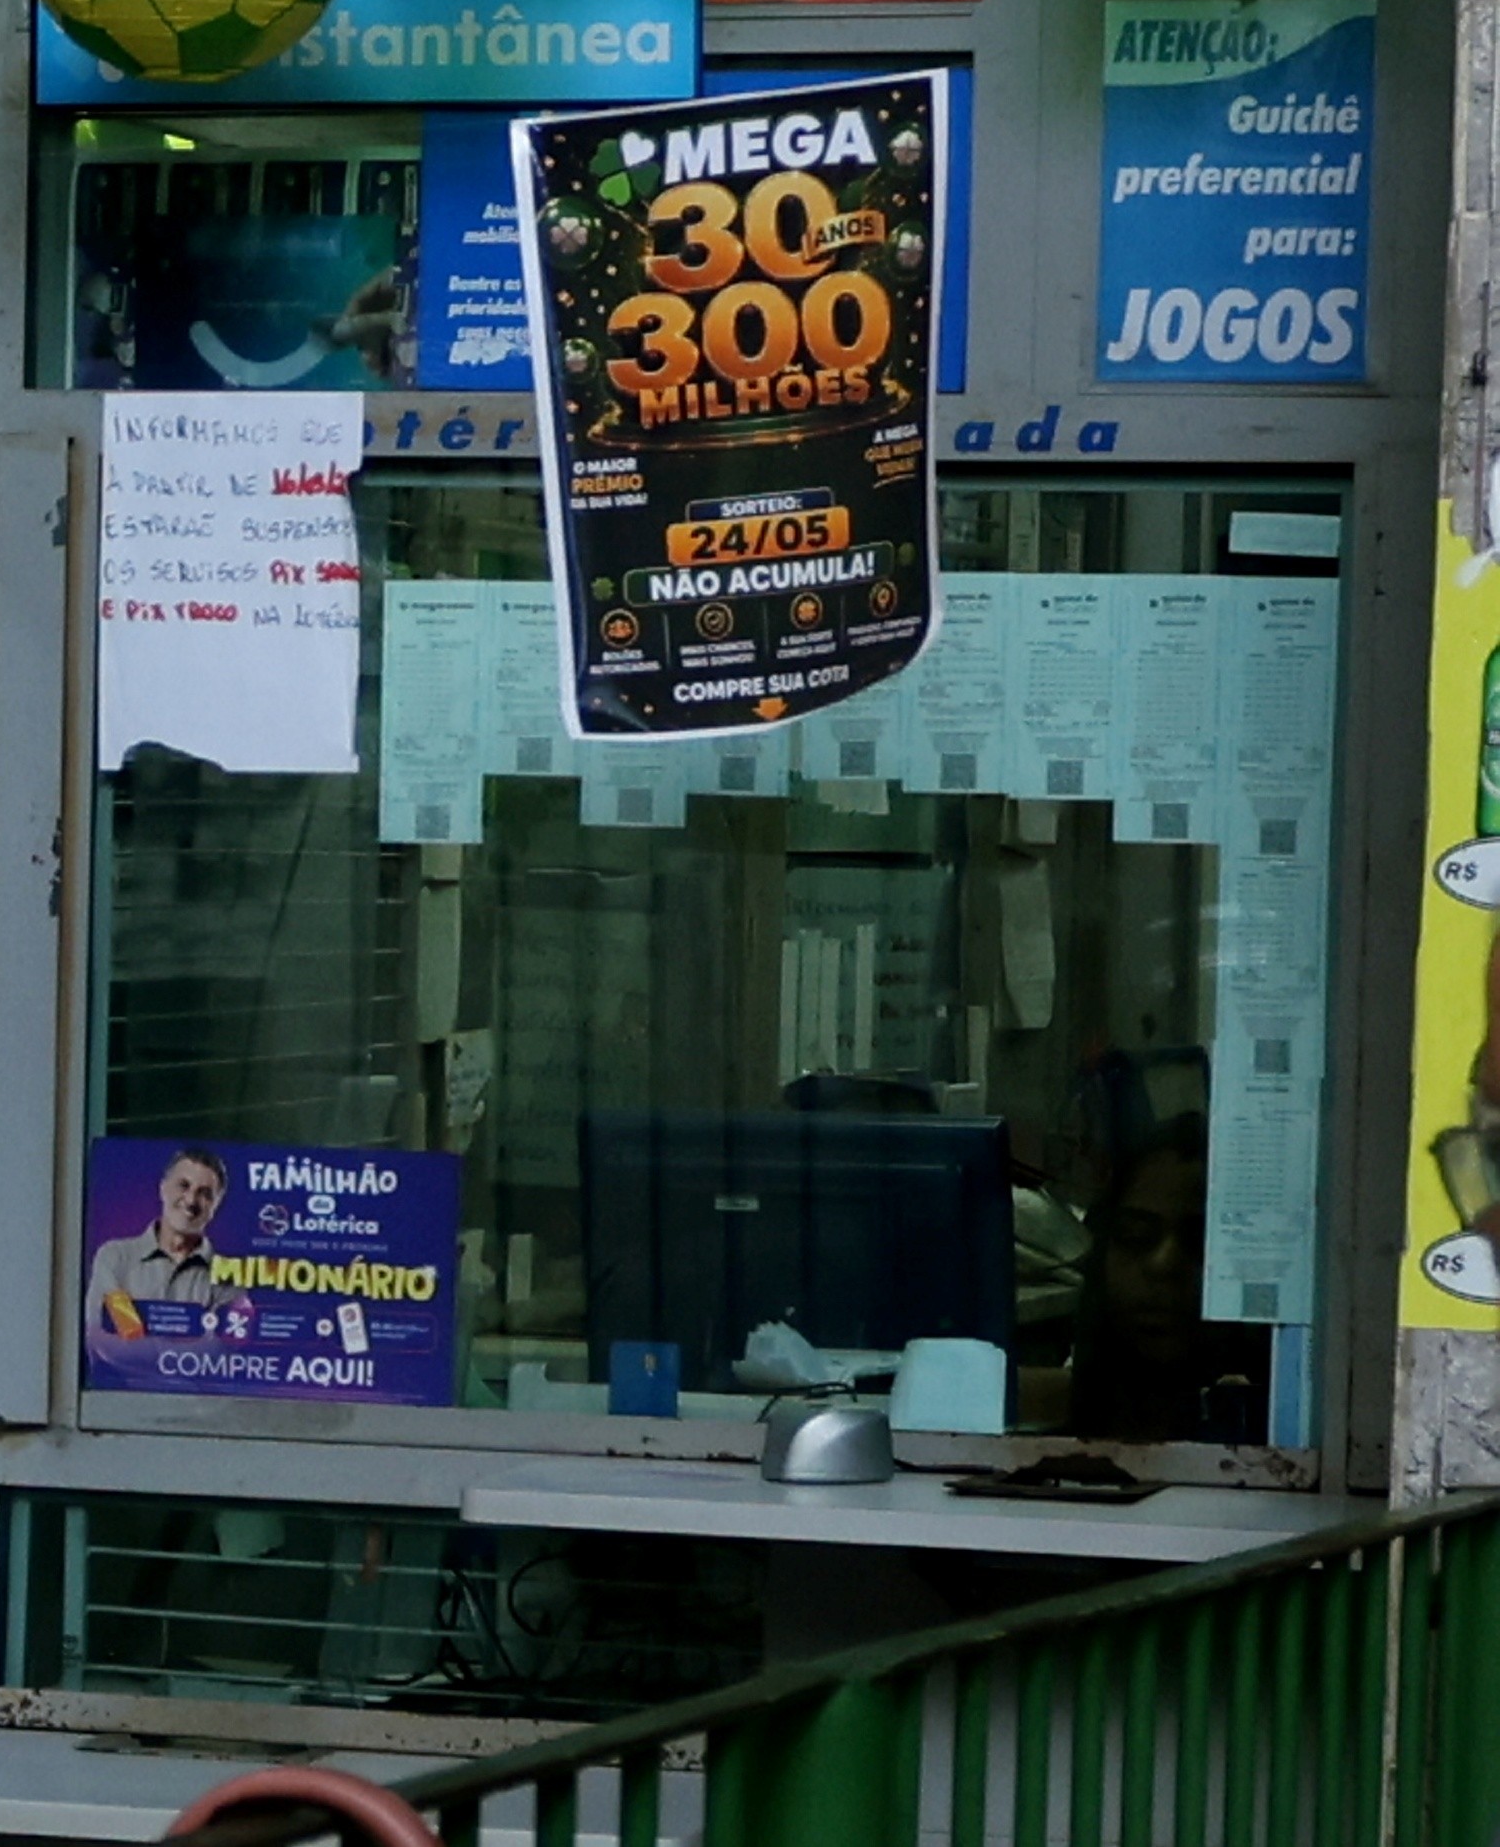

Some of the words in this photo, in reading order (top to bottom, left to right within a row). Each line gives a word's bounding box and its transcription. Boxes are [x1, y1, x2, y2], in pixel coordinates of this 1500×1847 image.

[1228, 92, 1360, 135] Guichê
[664, 109, 877, 185] MEGA
[1113, 153, 1361, 202] preferencial
[647, 171, 839, 294] 30
[812, 212, 876, 249] ANOS
[1245, 226, 1356, 263] para:
[605, 270, 892, 394] 300
[1107, 288, 1358, 365] JOGOS
[639, 363, 871, 430] MILHÕES
[720, 496, 802, 519] SORTEIO:
[689, 513, 831, 562] 24/05
[649, 567, 721, 601] NÃO
[728, 551, 875, 595] ACUMULA!
[673, 676, 765, 703] COMPRE
[768, 671, 804, 693] SUA
[808, 664, 849, 686] COTA
[1445, 862, 1478, 881] R$
[293, 1212, 380, 1235] Lotérica
[210, 1254, 437, 1301] MILIONÁRIO
[1431, 1253, 1465, 1273] R$
[158, 1350, 280, 1381] COMPRE
[286, 1357, 374, 1386] AQUI!
